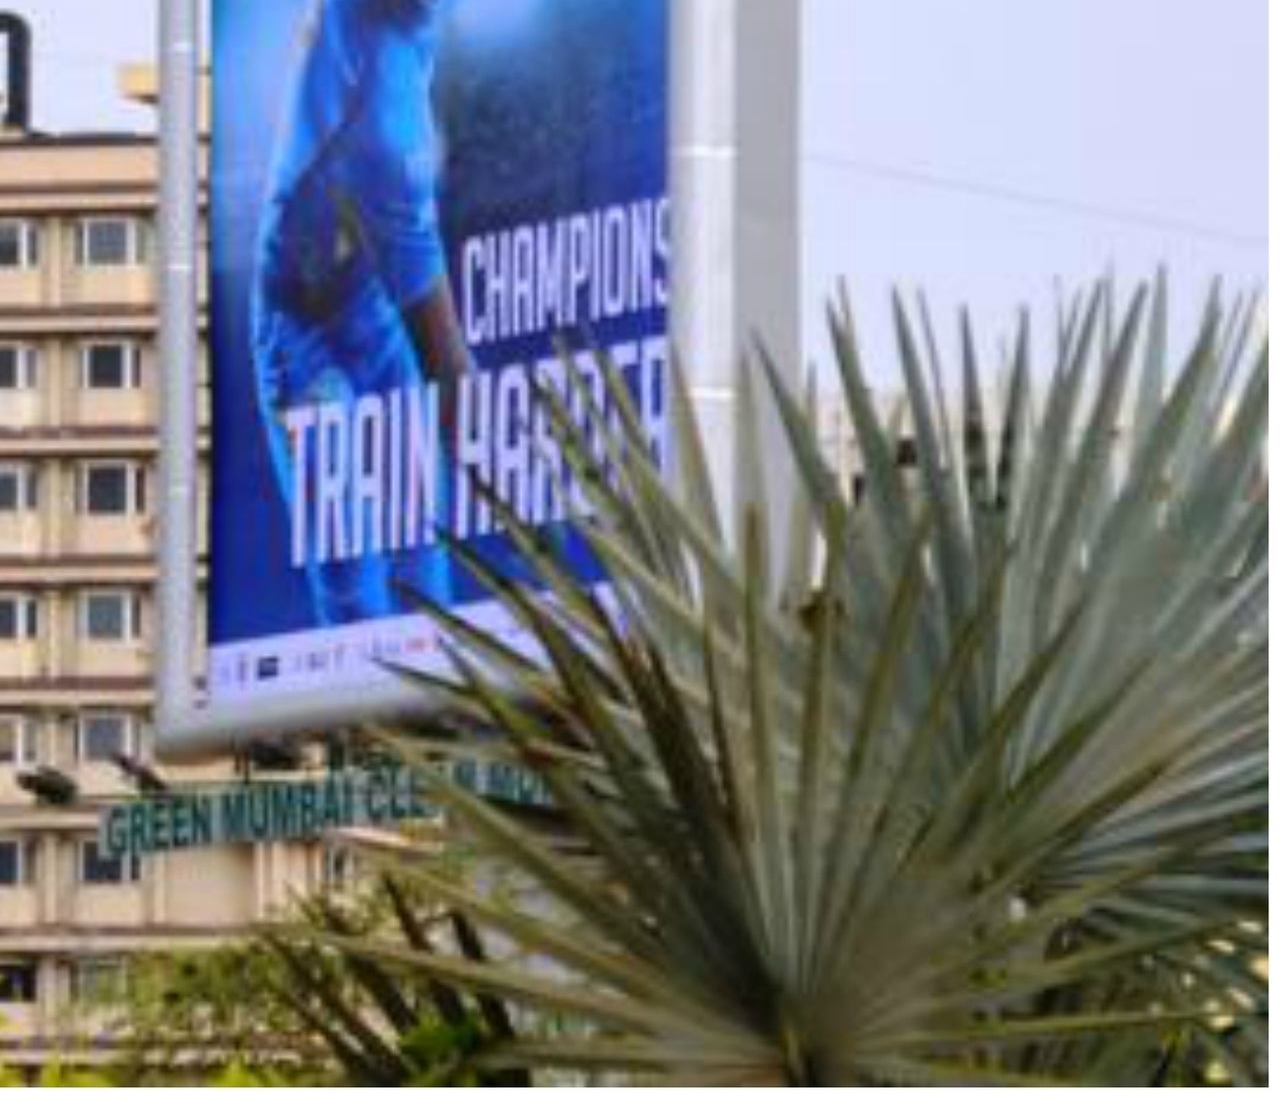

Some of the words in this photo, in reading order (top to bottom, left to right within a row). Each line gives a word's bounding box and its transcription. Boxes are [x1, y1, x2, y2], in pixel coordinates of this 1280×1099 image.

[286, 379, 440, 568] TRAIN
[106, 801, 211, 859] GREEN
[223, 771, 354, 842] MUMBAI
